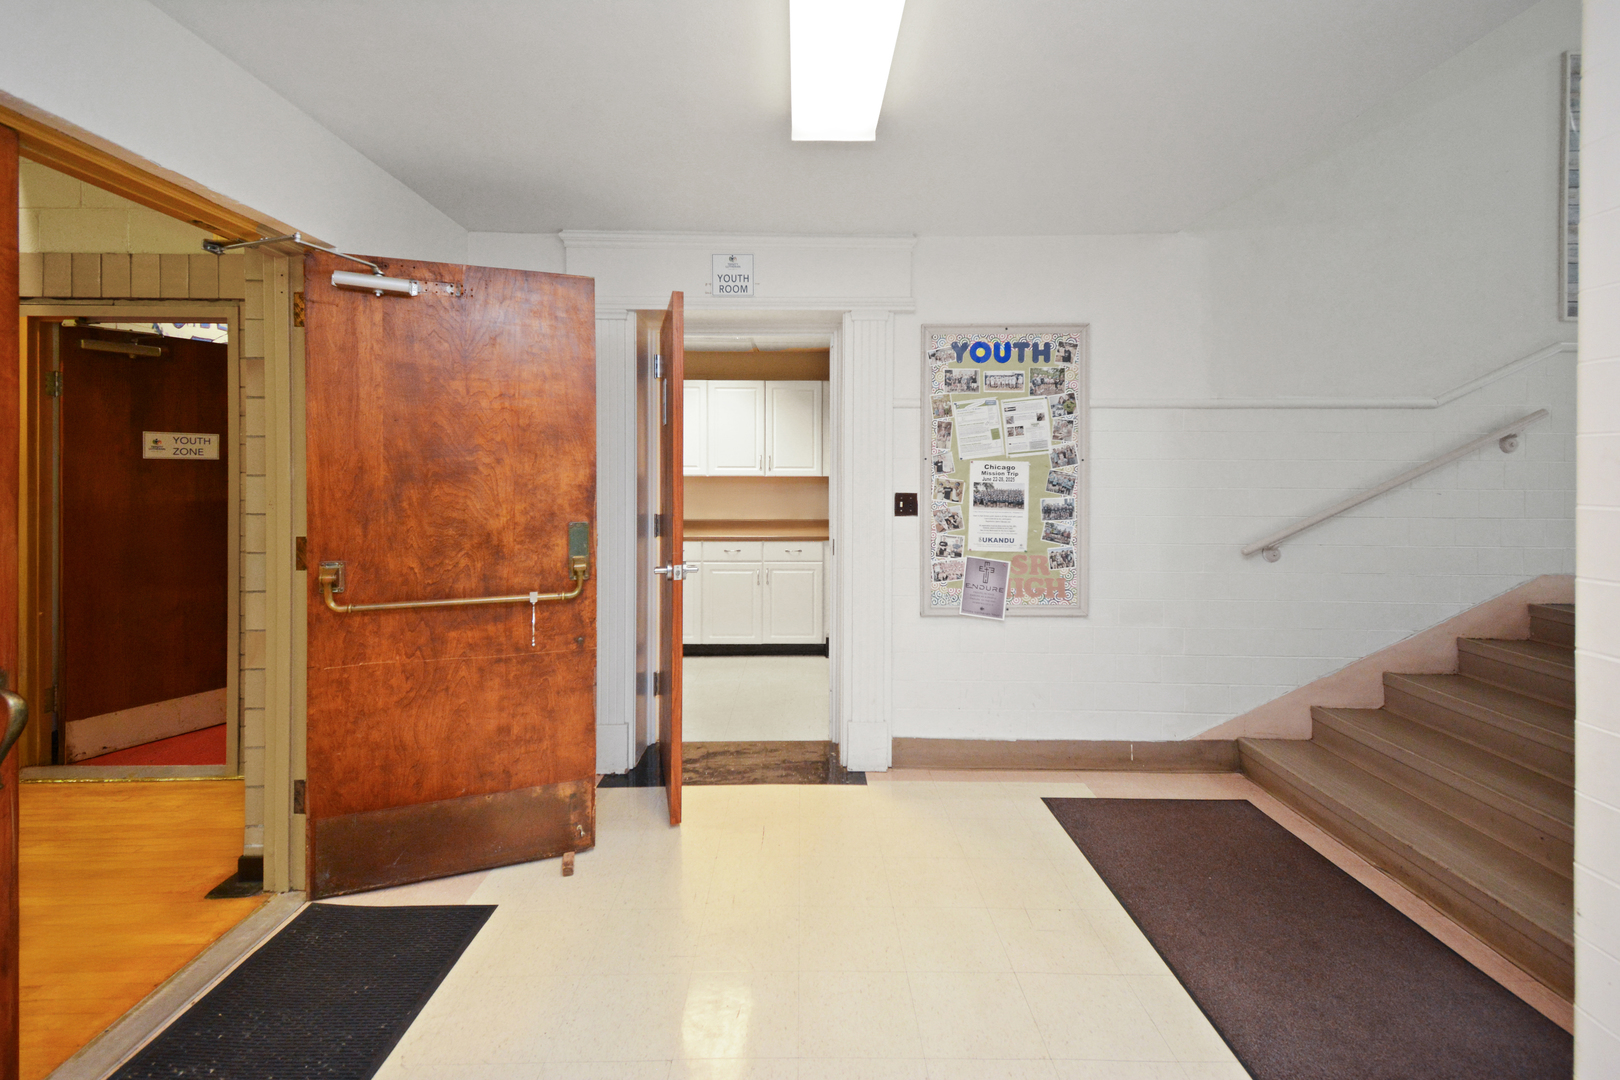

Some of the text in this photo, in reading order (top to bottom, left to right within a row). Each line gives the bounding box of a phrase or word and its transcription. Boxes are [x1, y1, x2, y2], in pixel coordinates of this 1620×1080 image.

[717, 274, 750, 283] YOUTH
[719, 284, 748, 293] ROOM
[951, 341, 1051, 364] YOUTH
[172, 436, 211, 445] YOUTH
[172, 447, 204, 456] ZONE
[1011, 554, 1051, 576] SR
[965, 583, 1005, 593] ENDURE
